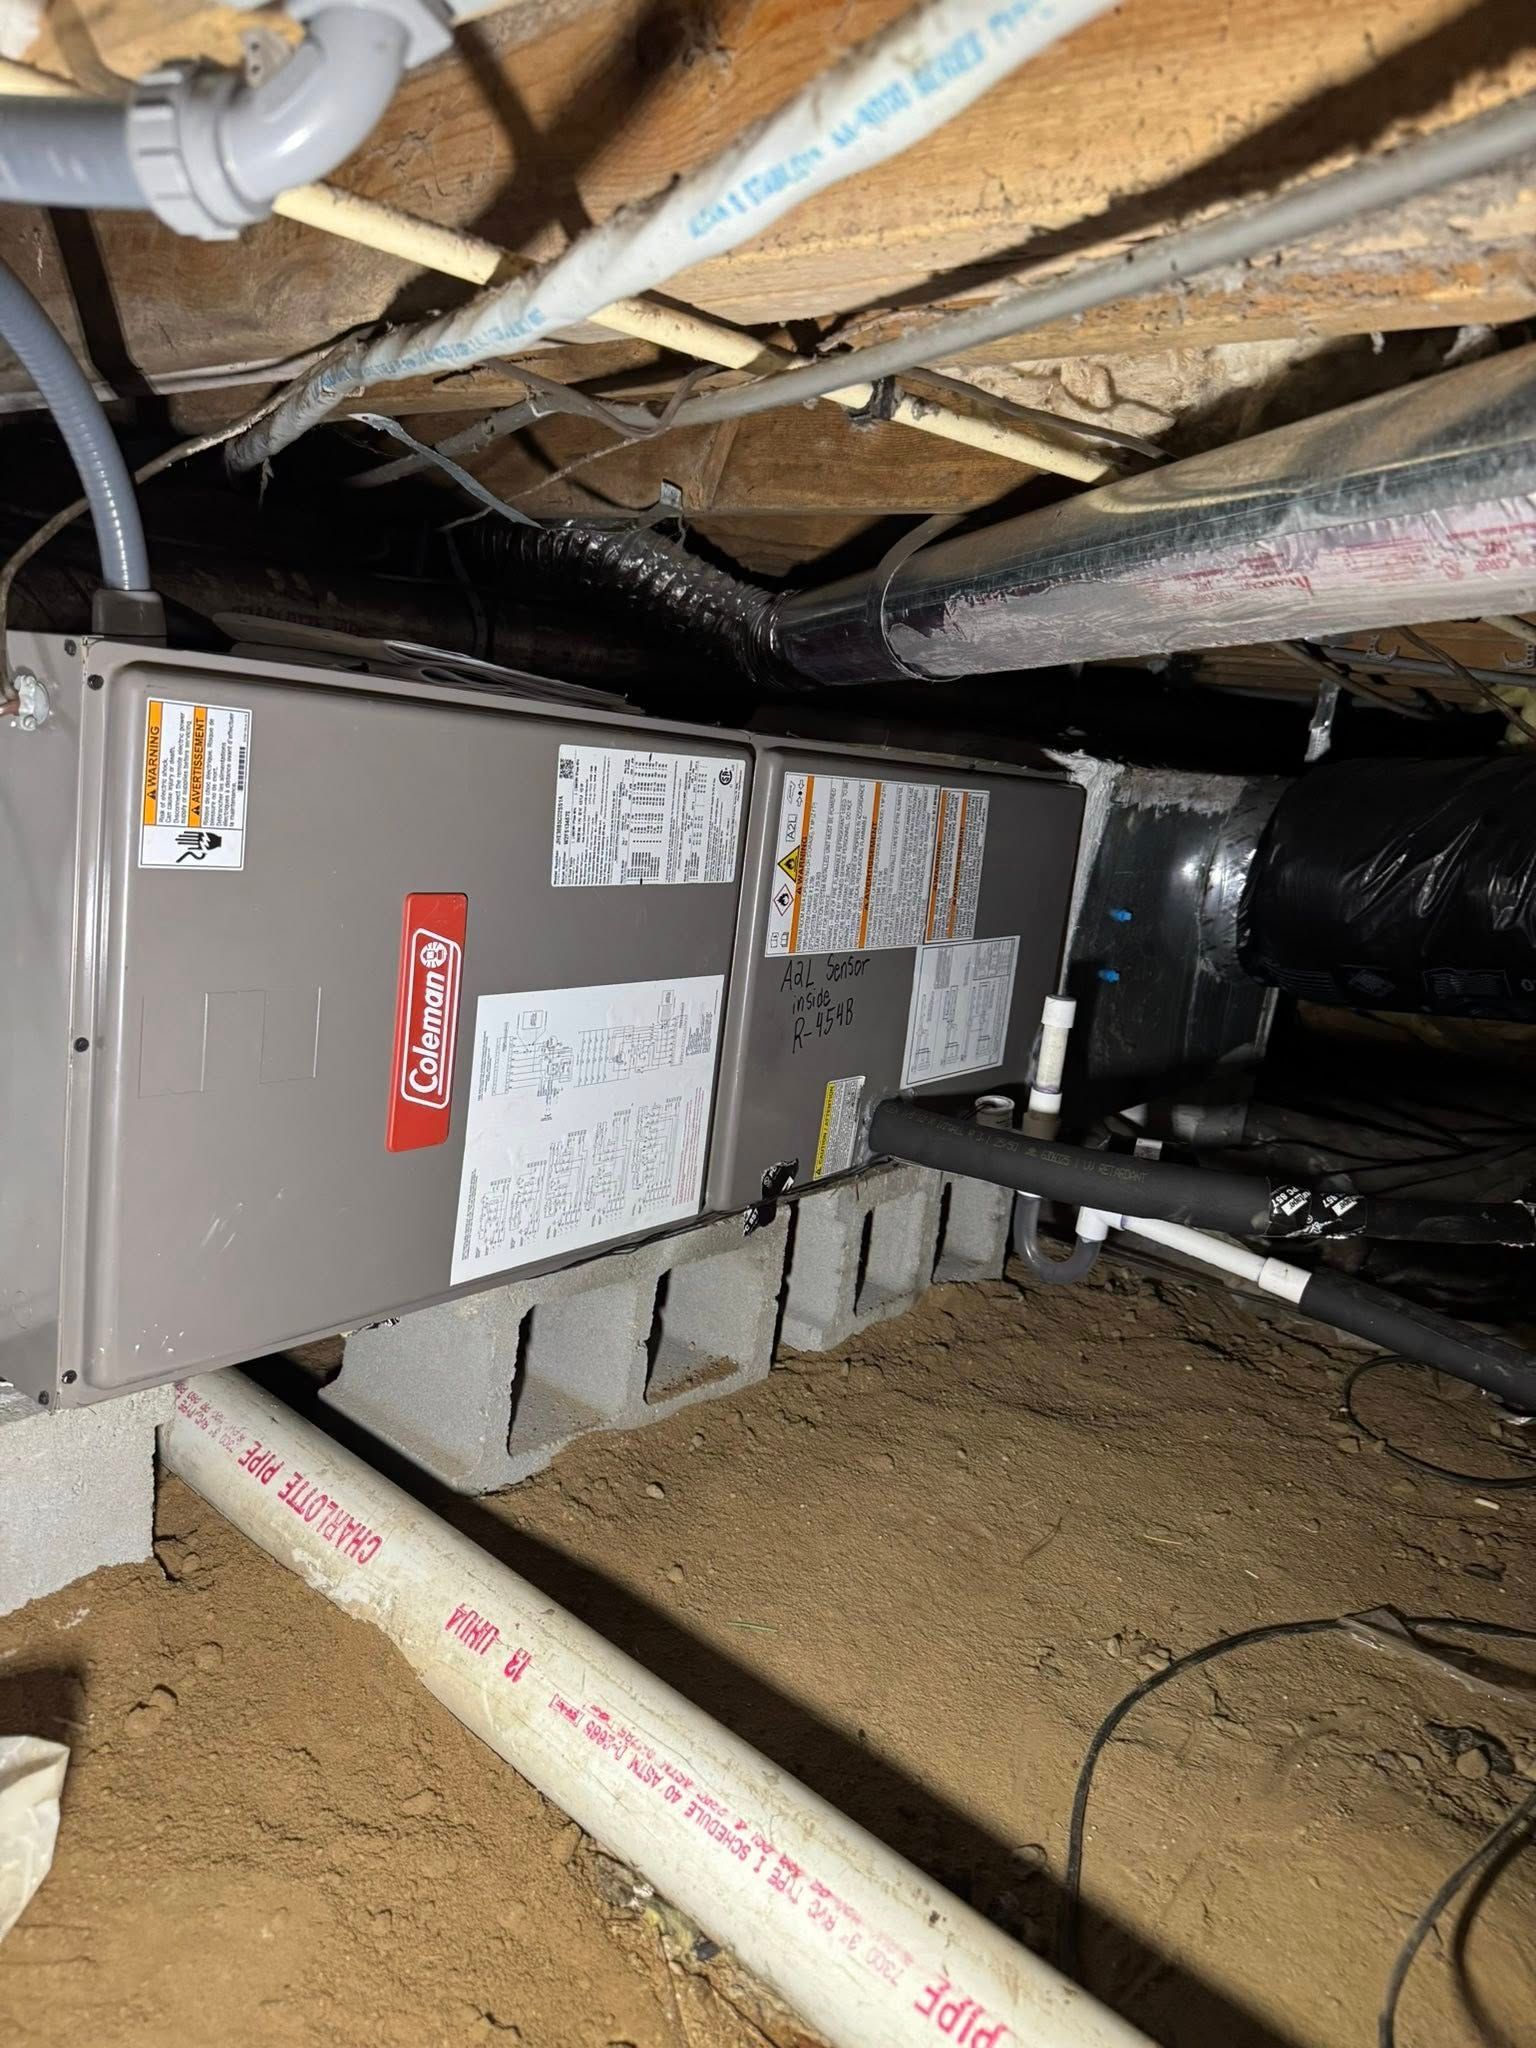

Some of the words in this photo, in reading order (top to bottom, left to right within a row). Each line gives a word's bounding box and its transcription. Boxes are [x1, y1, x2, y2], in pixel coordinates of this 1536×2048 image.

[147, 726, 159, 786] WARNING
[192, 718, 204, 803] AVERTISSEMENT
[786, 815, 797, 839] A2L
[796, 836, 807, 885] WARNING
[864, 820, 877, 899] AVERTISSEMENT
[933, 841, 942, 885] WARNING
[953, 824, 965, 899] AVERTISSEMENT
[826, 953, 870, 982] Sensor
[792, 988, 831, 1015] inside
[792, 997, 854, 1054] R-454B
[409, 971, 445, 1094] Coleman
[819, 1133, 827, 1164] CAUTION
[825, 1086, 834, 1126] ATTENTION
[1271, 1192, 1289, 1208] 857
[1286, 1186, 1300, 1196] PC
[237, 1440, 285, 1485] PIPE
[278, 1471, 383, 1564] CHARLOTTE
[627, 1753, 664, 1789] ASTM
[662, 1784, 683, 1804] 40
[684, 1799, 752, 1861] SCHEDULE
[766, 1866, 804, 1905] TYPE
[914, 1972, 1008, 2048] PIPE
